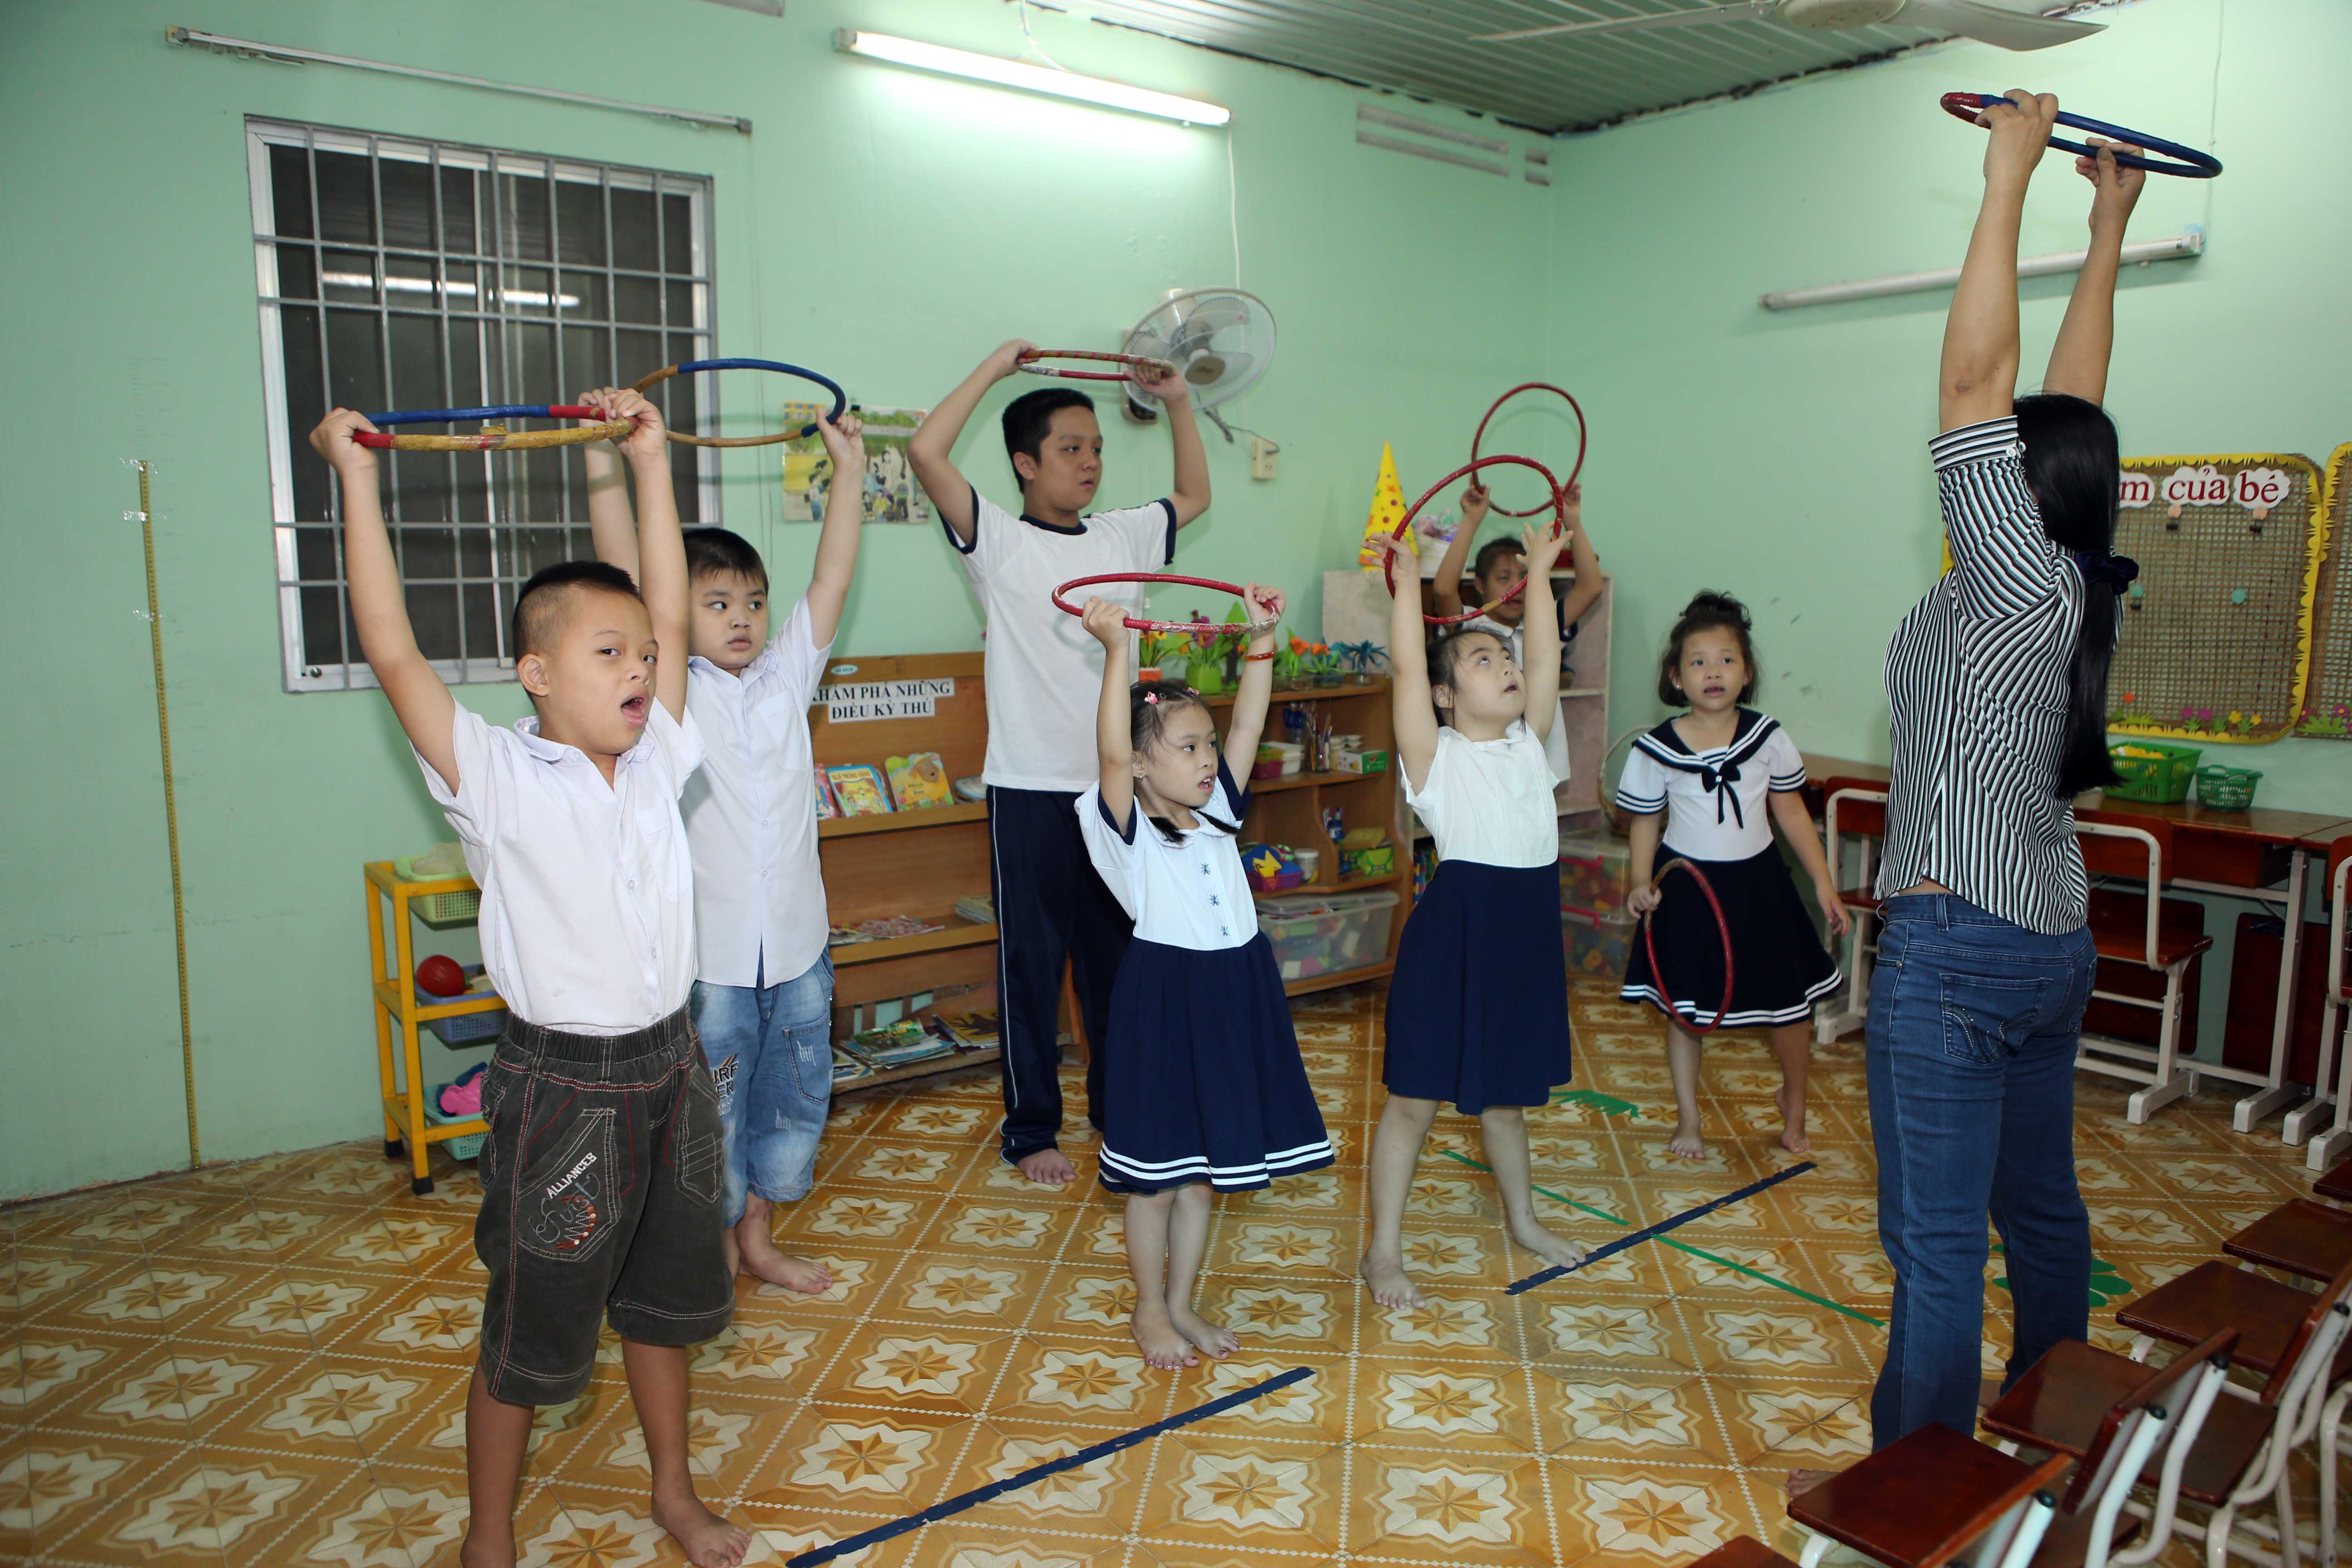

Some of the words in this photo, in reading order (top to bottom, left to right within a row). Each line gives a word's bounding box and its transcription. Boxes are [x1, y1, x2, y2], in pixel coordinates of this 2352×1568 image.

[2120, 480, 2150, 501] m
[2168, 467, 2226, 500] của
[2239, 471, 2279, 503] bé
[813, 684, 855, 701] HÁM
[897, 680, 950, 697] NHỮNG
[901, 697, 931, 714] THÚ
[715, 1080, 734, 1098] ER
[546, 1152, 597, 1199] ALLIANCES
